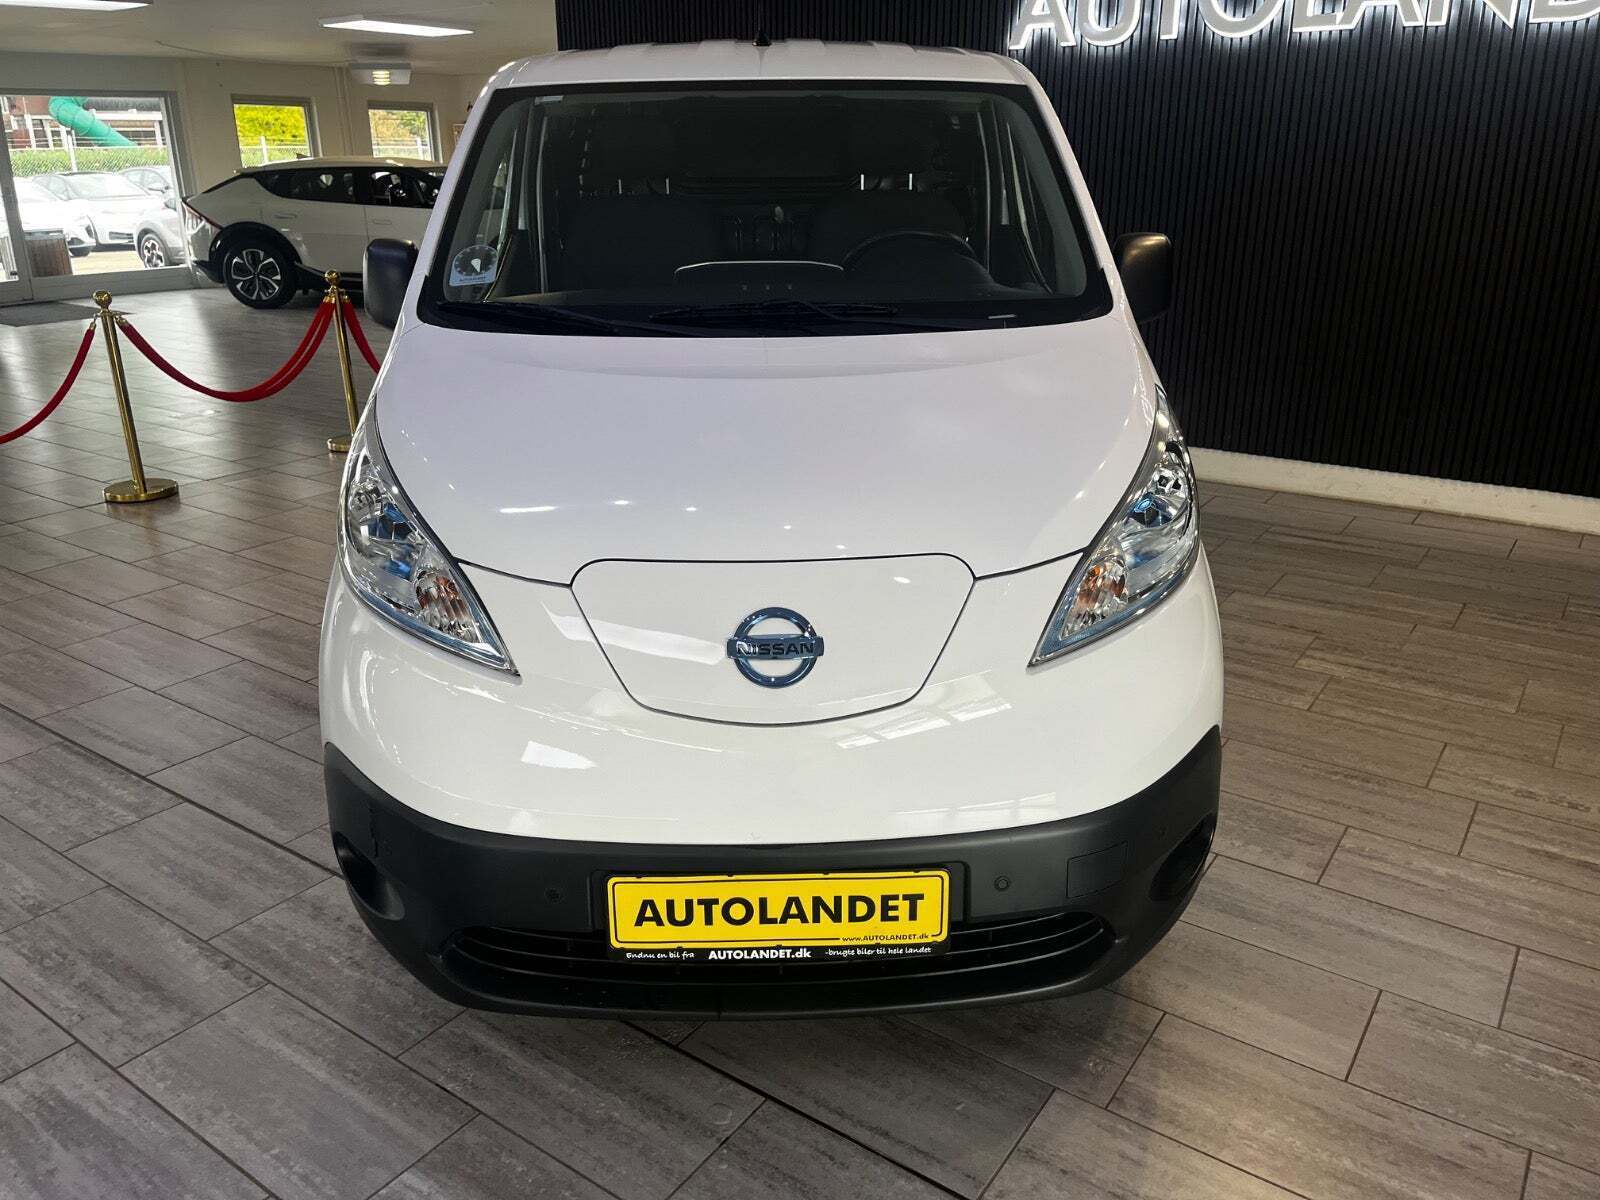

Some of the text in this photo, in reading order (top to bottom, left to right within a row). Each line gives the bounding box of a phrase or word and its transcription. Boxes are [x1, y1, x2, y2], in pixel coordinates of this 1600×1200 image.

[737, 641, 814, 655] NISSAN
[634, 893, 925, 927] AUTOLANDET
[841, 933, 929, 942] www.AUTOLANDET.dk
[626, 951, 655, 959] Endnu
[668, 951, 681, 959] bil
[682, 950, 695, 960] fra
[709, 949, 811, 960] AUTOLANDET.dk
[856, 947, 876, 956] biler
[876, 947, 887, 955] til
[888, 947, 904, 955] hele
[905, 946, 932, 954] landet
